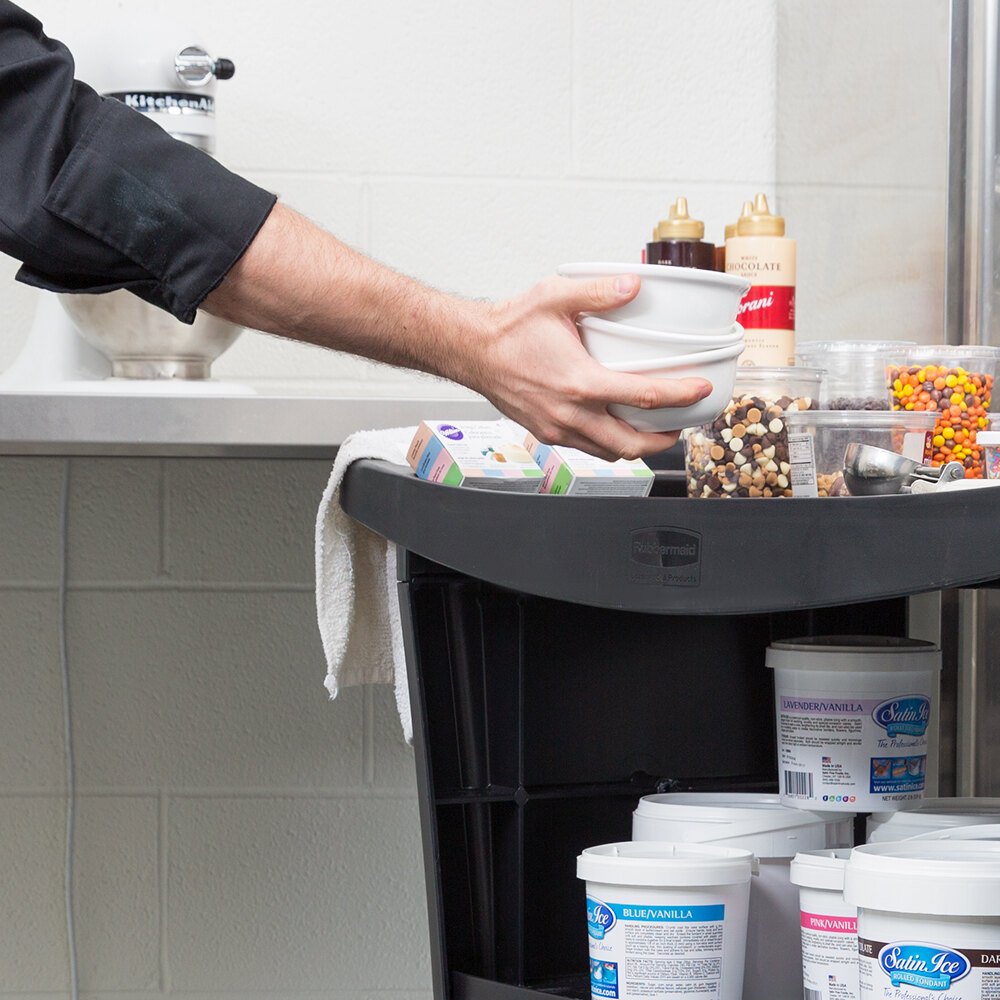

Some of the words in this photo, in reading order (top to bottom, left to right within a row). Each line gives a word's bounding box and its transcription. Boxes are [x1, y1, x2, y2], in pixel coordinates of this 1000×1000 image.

[737, 291, 774, 315] orani
[783, 700, 864, 712] LAVENDER/VANILLA
[881, 702, 918, 722] Satin
[593, 905, 610, 925] Ice
[622, 908, 693, 919] BLUE/VANILLA
[810, 917, 858, 930] PINK/VANILL
[884, 946, 927, 972] Satin
[925, 952, 960, 974] Ice
[893, 974, 915, 982] ROLLED
[916, 978, 947, 988] FONDANT
[883, 987, 893, 999] The
